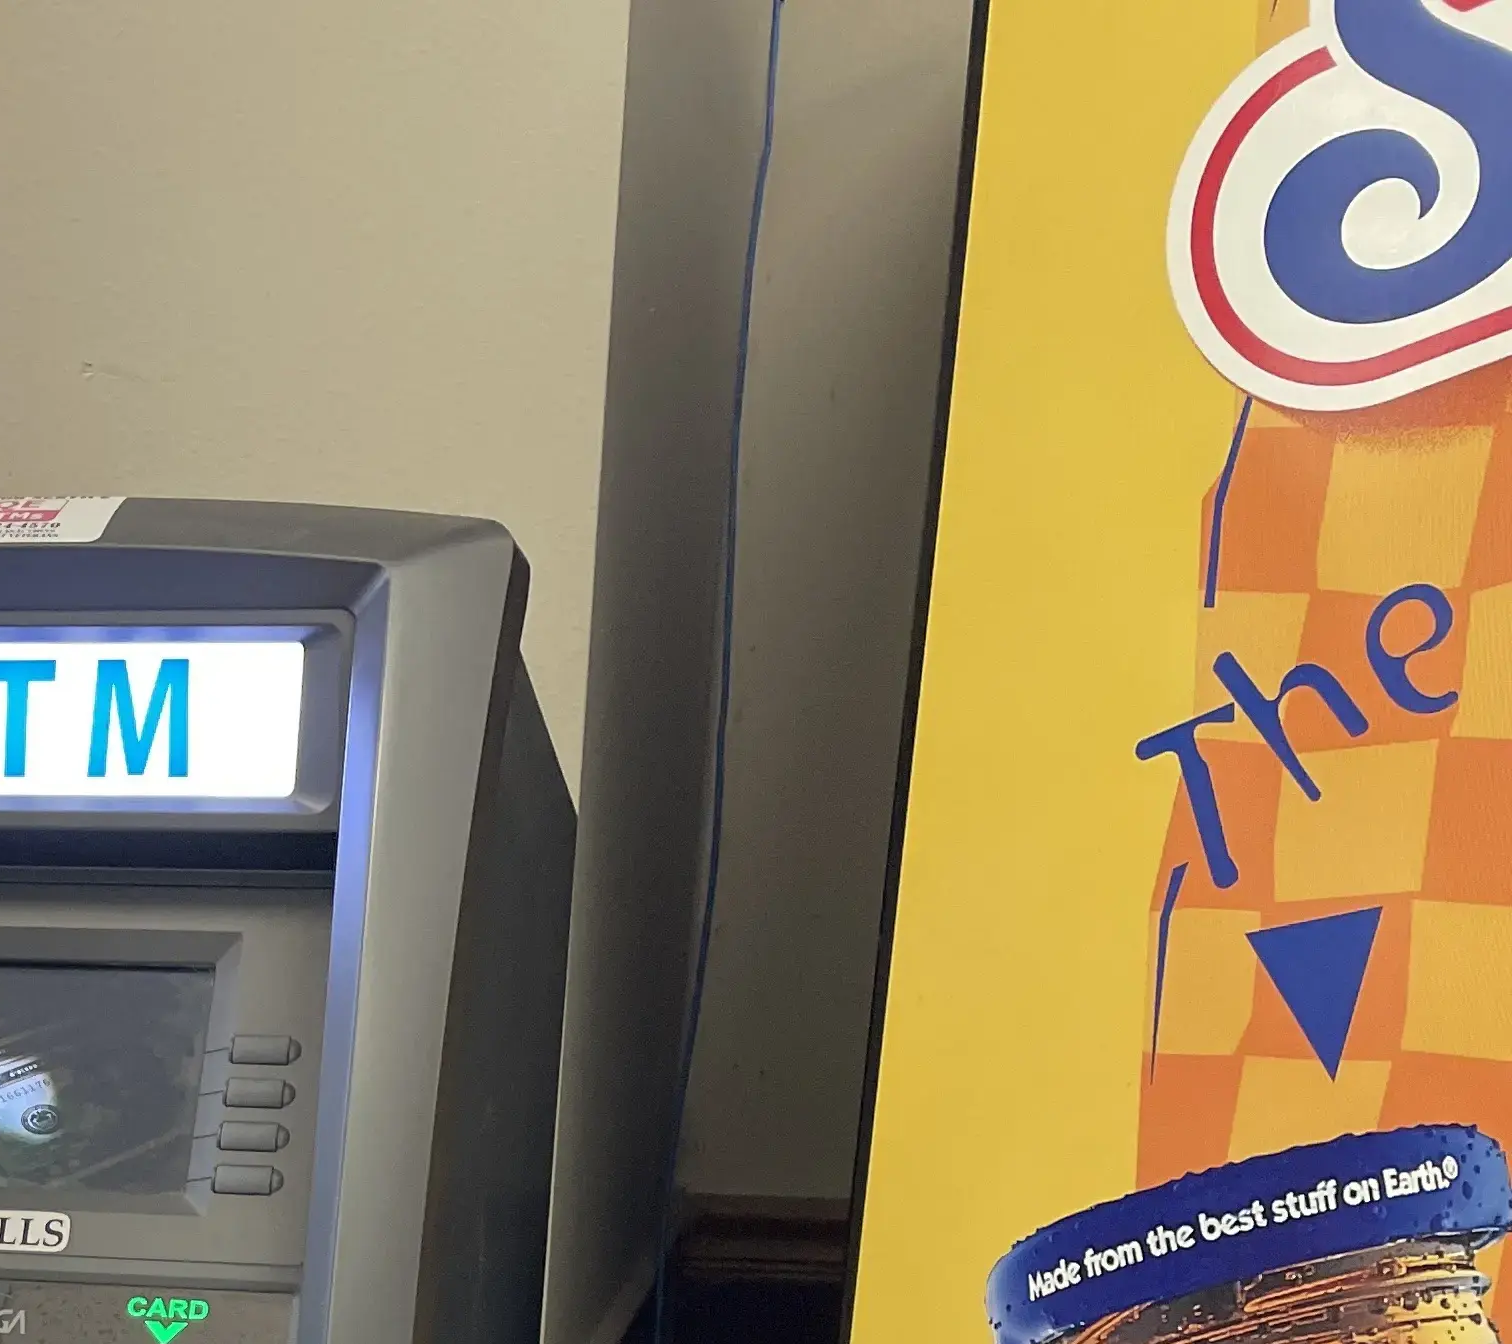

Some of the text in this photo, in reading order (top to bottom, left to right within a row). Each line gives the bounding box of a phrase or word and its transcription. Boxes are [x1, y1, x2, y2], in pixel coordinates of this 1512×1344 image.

[1136, 584, 1458, 889] The
[1028, 1259, 1082, 1302] Made
[1083, 1238, 1144, 1281] from
[1146, 1222, 1196, 1260] the
[1198, 1201, 1269, 1242] best
[1271, 1178, 1339, 1225] stuff
[1343, 1178, 1381, 1206] on
[127, 1296, 210, 1321] CARD
